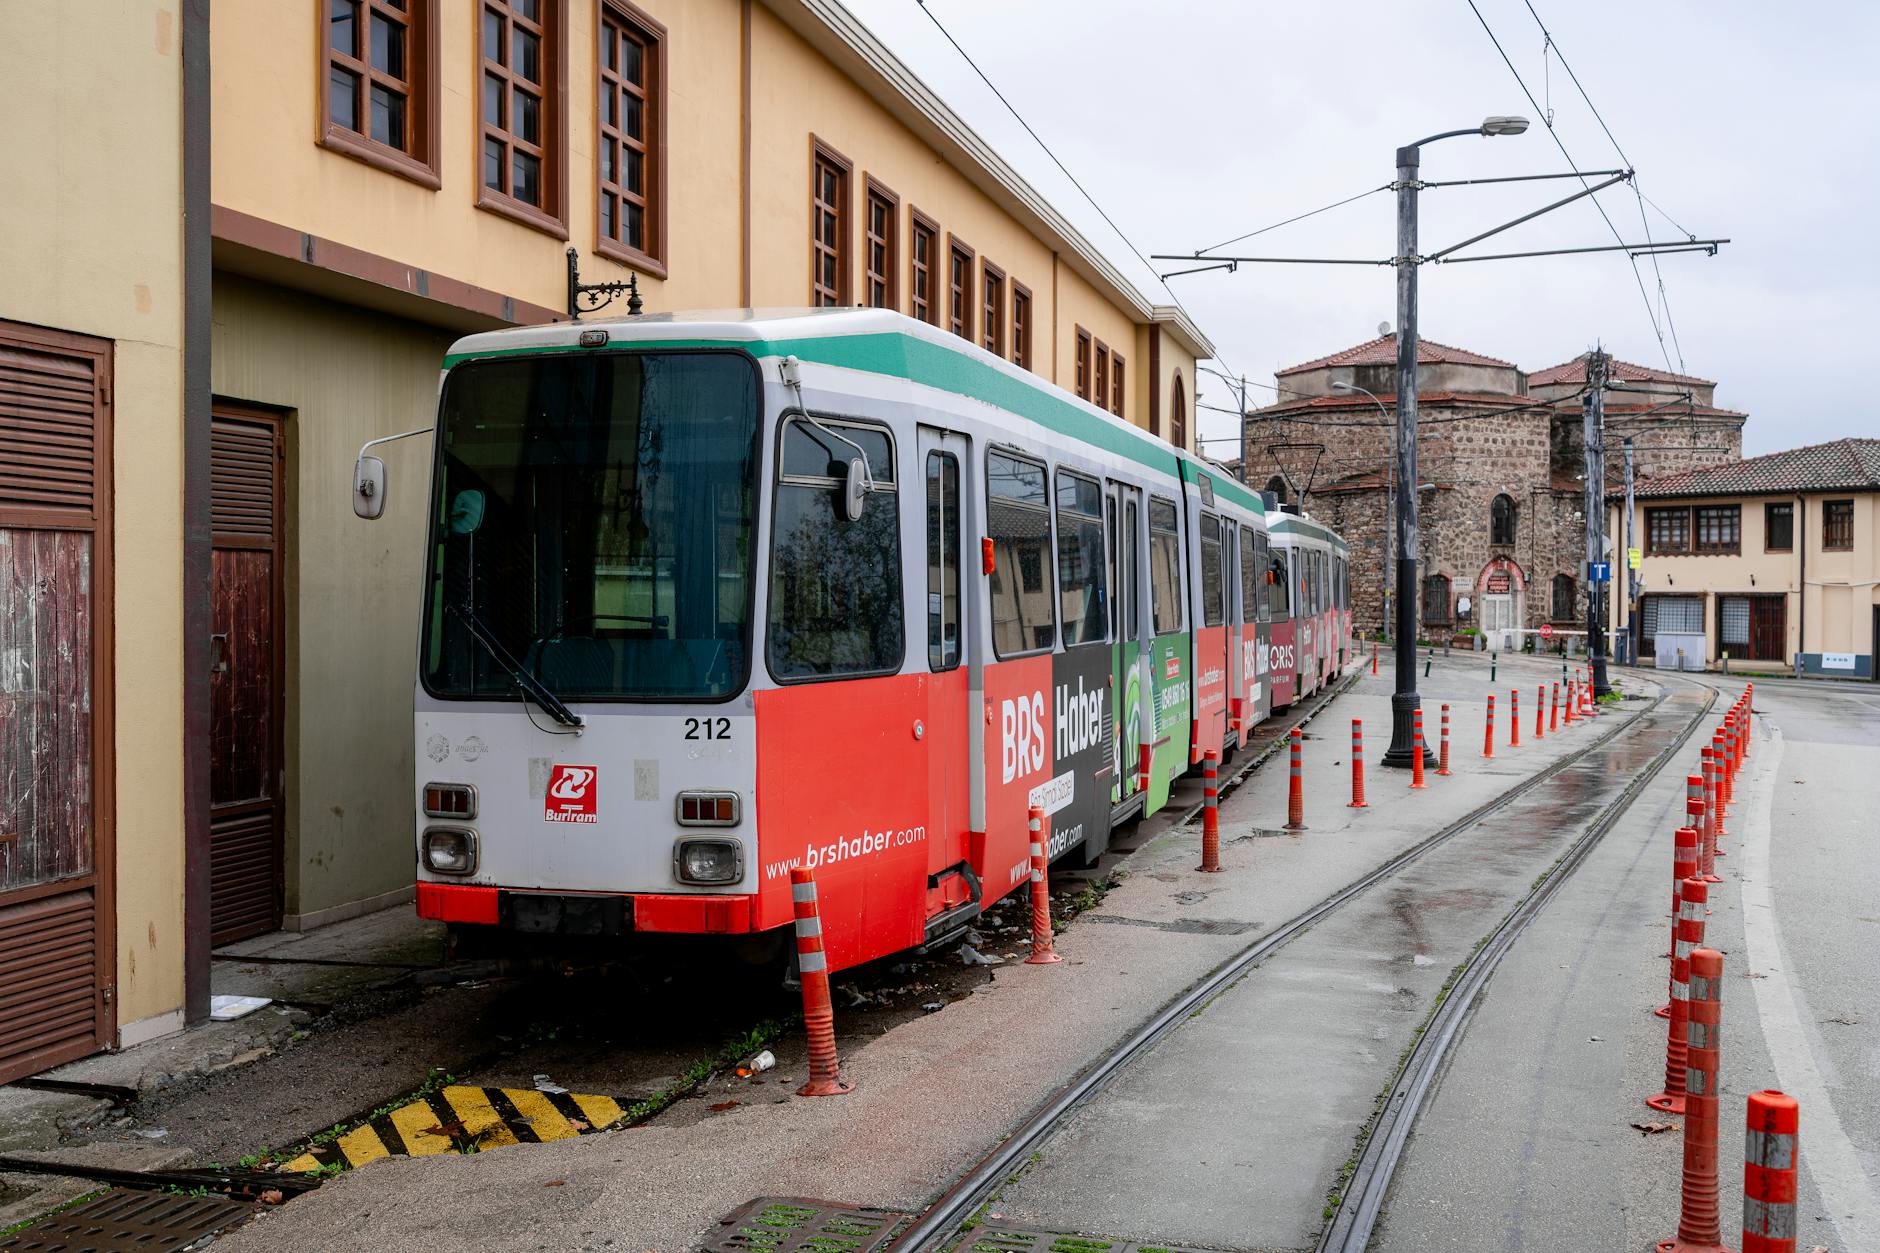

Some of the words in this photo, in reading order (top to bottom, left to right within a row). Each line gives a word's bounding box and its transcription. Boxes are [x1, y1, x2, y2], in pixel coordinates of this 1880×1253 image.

[1594, 564, 1607, 579] T
[1270, 644, 1294, 670] ORIS
[684, 717, 731, 740] 212
[1002, 690, 1045, 784] BRS
[1056, 675, 1104, 761] Haber
[545, 804, 598, 824] BurTram
[766, 825, 926, 880] wwwbrshaber.com
